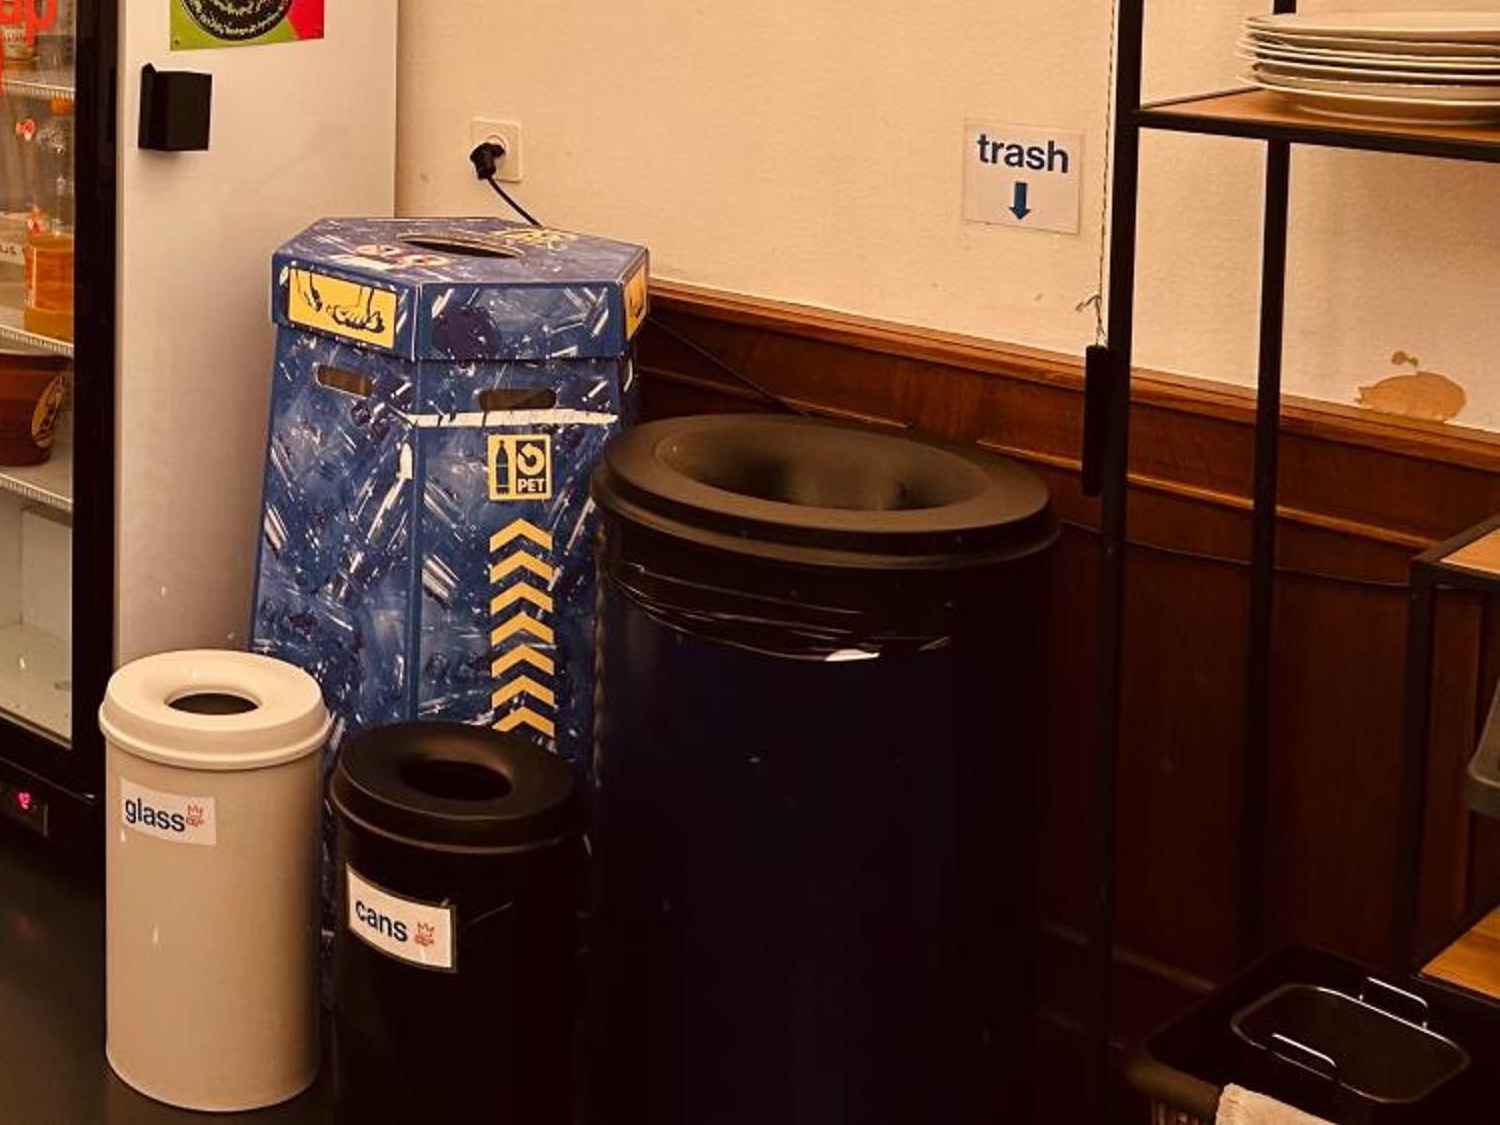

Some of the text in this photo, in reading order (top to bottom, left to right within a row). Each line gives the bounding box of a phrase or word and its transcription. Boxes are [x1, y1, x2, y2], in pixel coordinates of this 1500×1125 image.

[977, 133, 1069, 174] trash
[517, 478, 545, 493] PET
[125, 797, 186, 833] glass
[355, 900, 408, 943] cans
